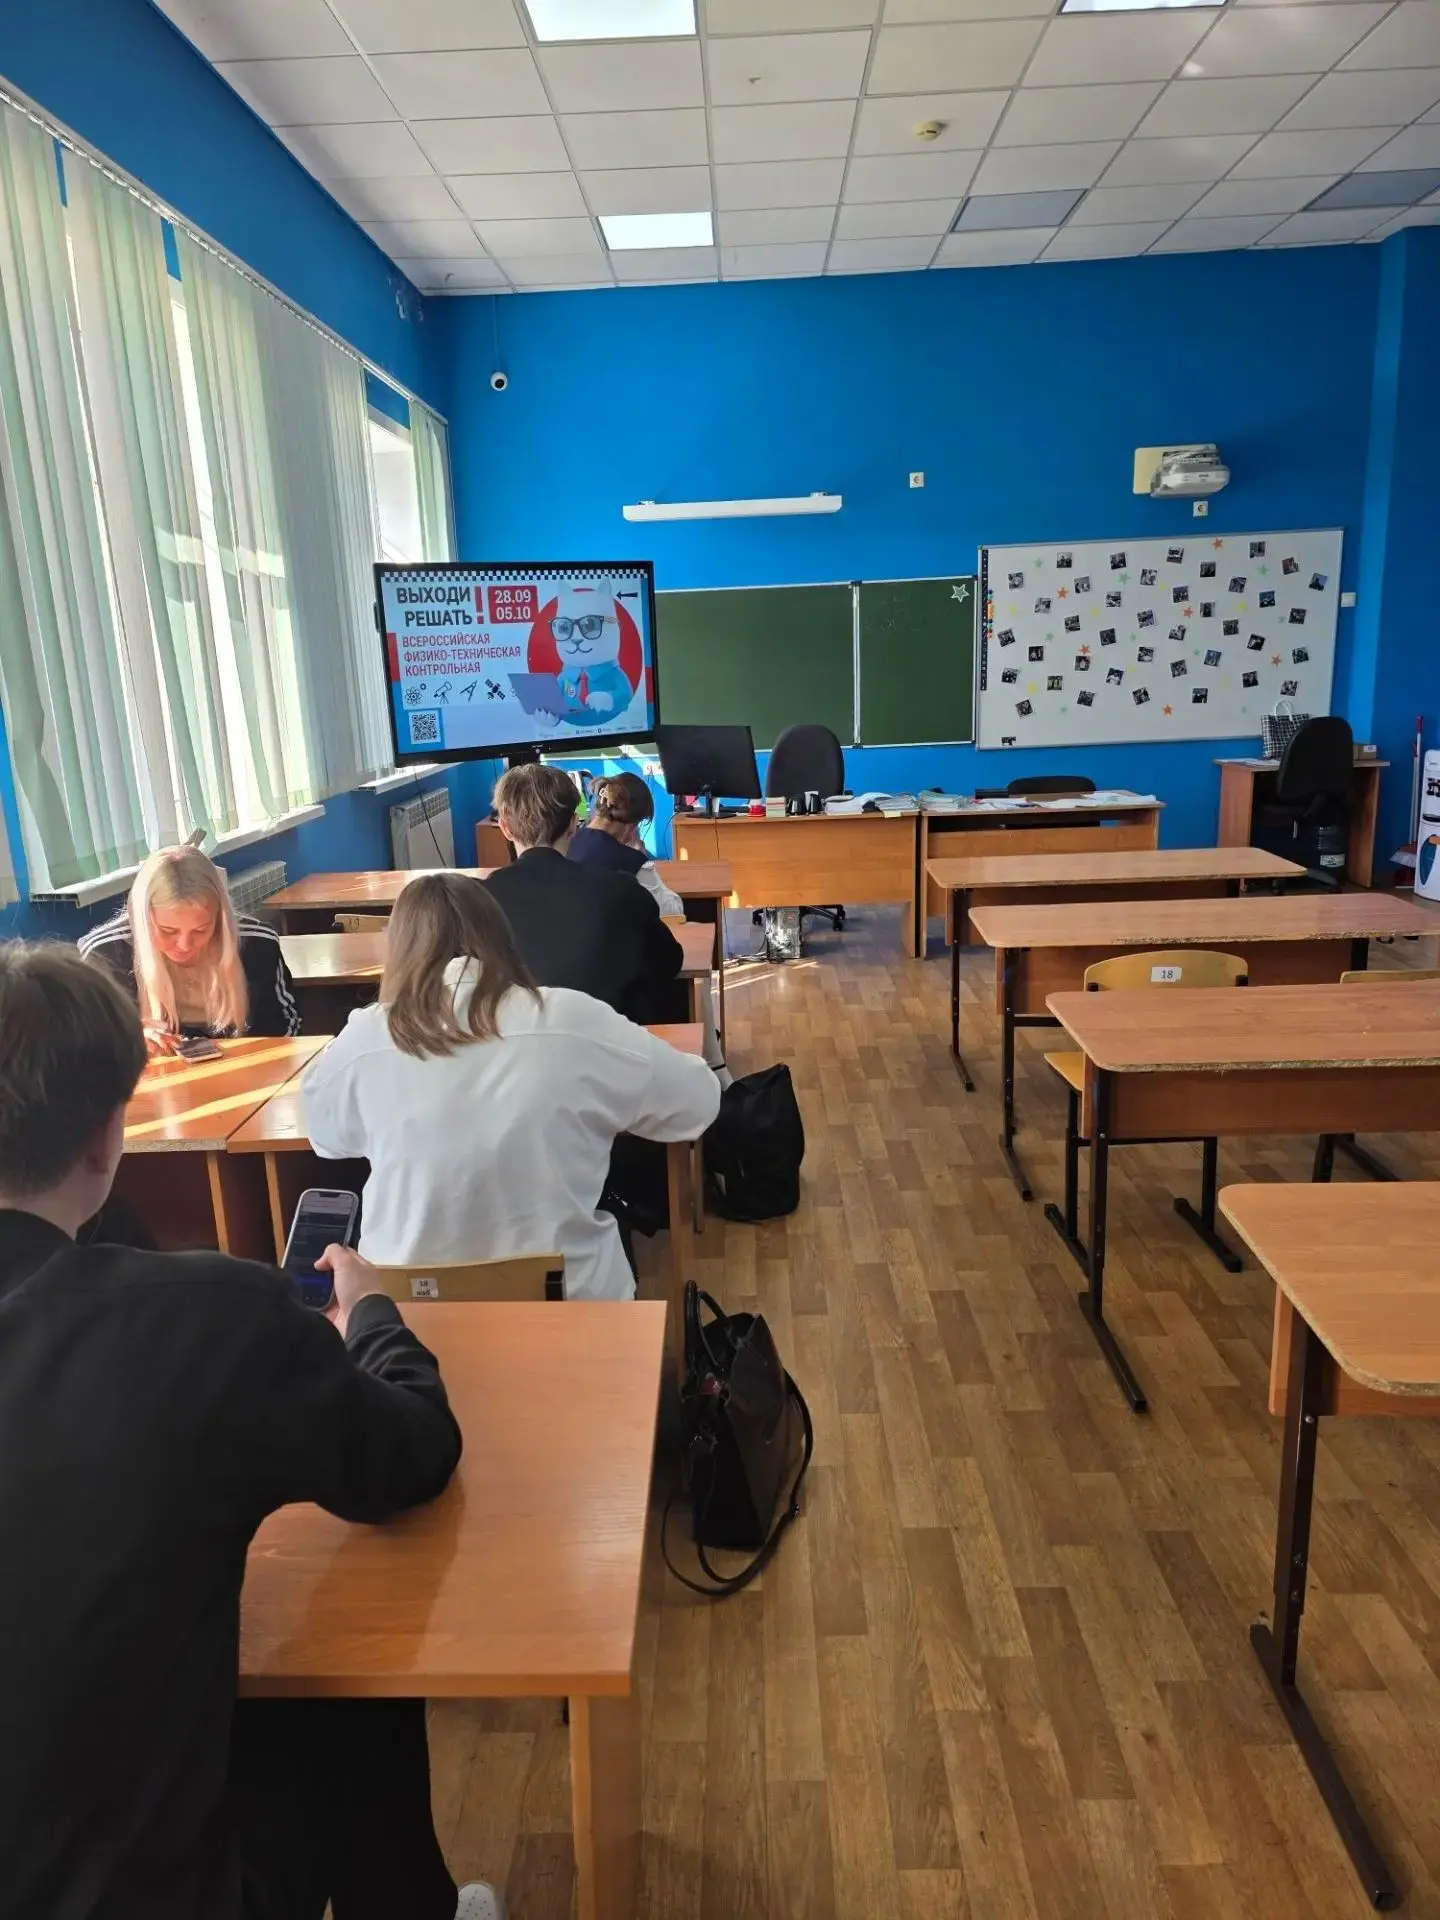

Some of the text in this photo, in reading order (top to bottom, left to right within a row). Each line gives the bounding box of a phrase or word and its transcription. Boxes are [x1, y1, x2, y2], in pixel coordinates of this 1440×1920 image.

[396, 586, 471, 606] ВЫХОДИ
[494, 589, 532, 604] 28.09
[404, 610, 473, 627] РЕШАТЬ
[496, 606, 531, 620] 05.10
[402, 632, 491, 648] ВСЕРОССИЙСКАЯ
[403, 646, 521, 662] ФИЗИКО-ТЕХНИЧЕСКАЯ
[405, 661, 481, 677] КОНТРОЛЬНАЯ
[1160, 969, 1174, 979] 18
